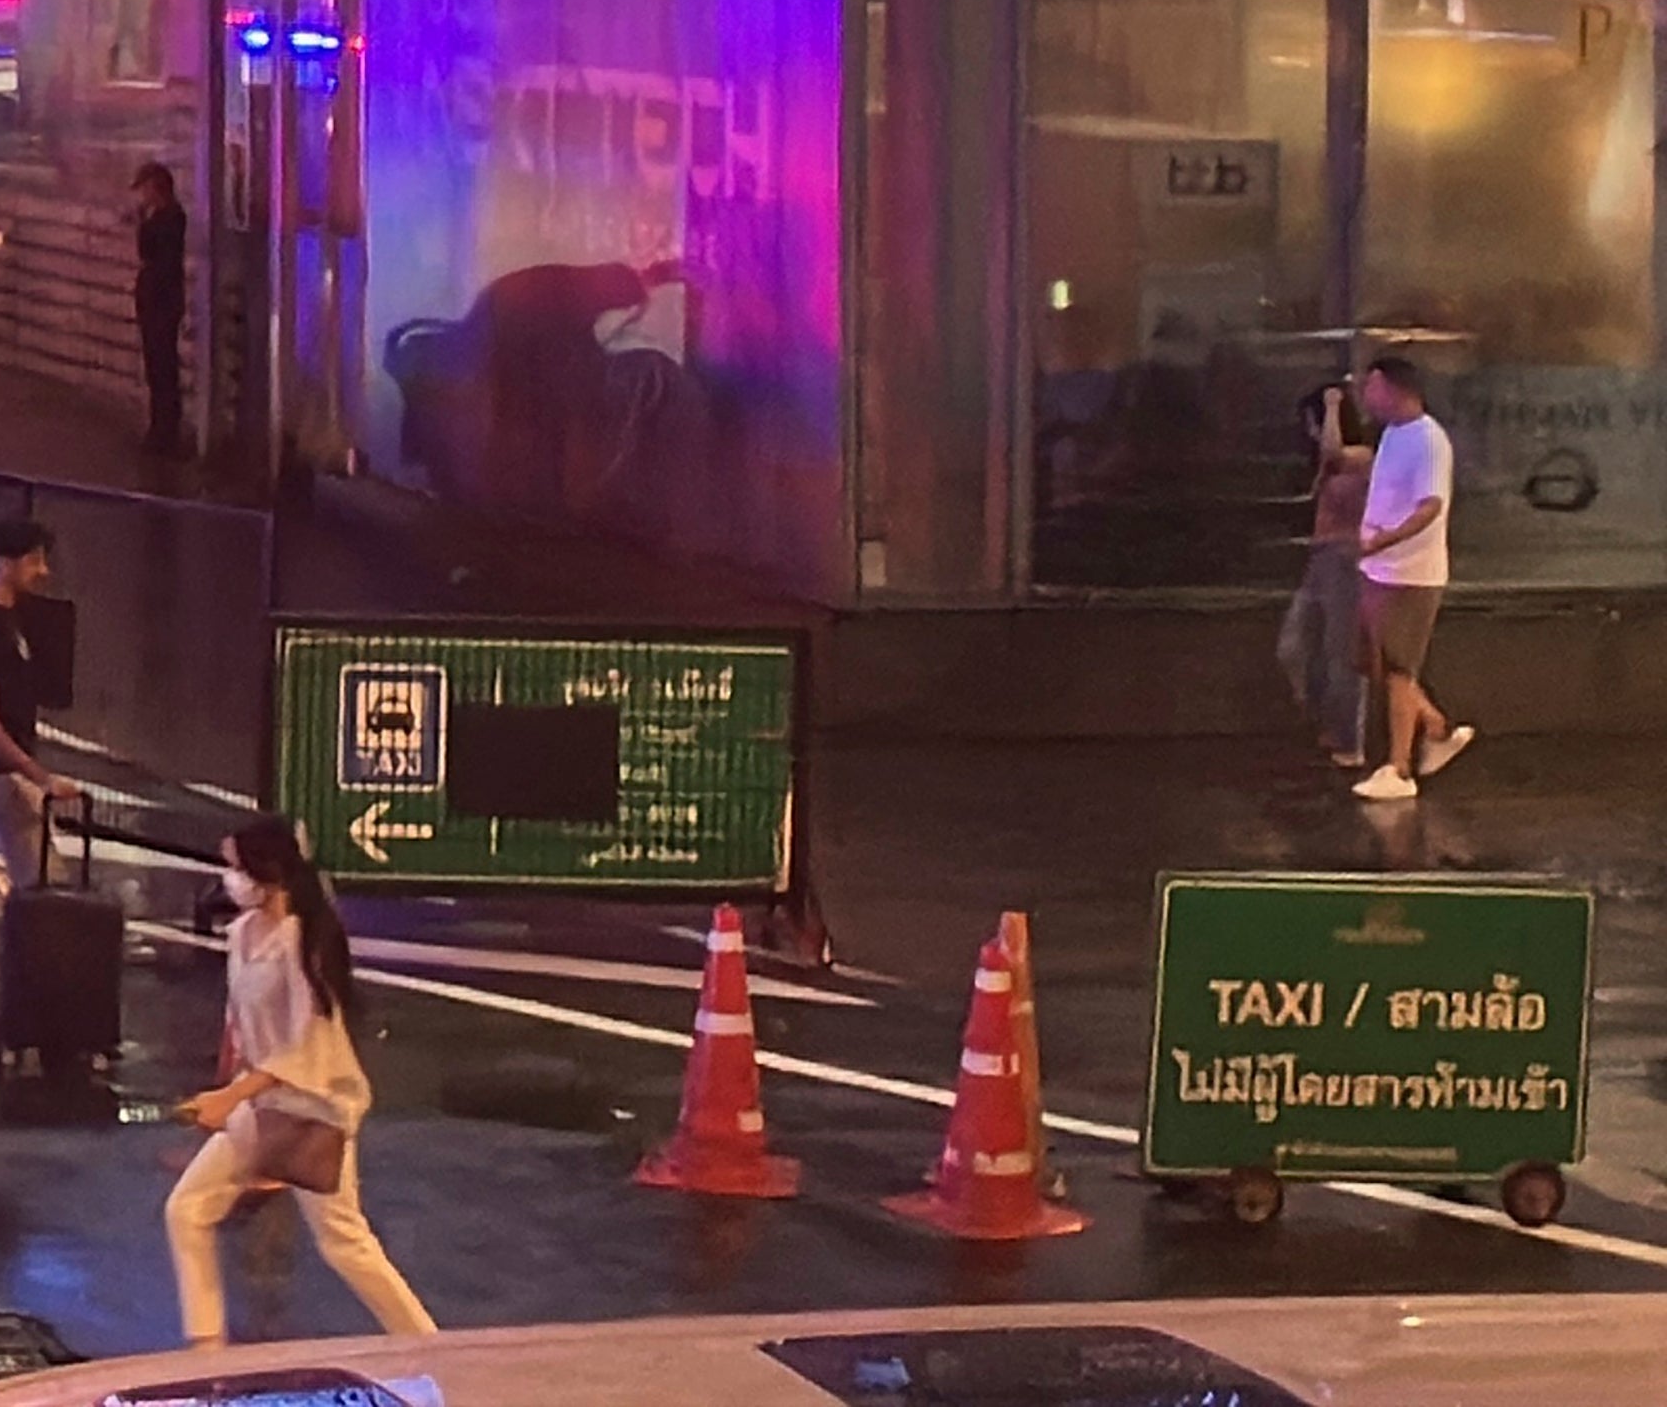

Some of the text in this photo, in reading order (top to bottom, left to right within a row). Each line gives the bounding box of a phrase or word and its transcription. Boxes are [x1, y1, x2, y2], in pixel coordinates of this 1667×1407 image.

[1208, 973, 1547, 1032] TAXI / สามล้อ
[1170, 1046, 1568, 1124] ไม่มีผู้โดยสารห้ามเข้า
